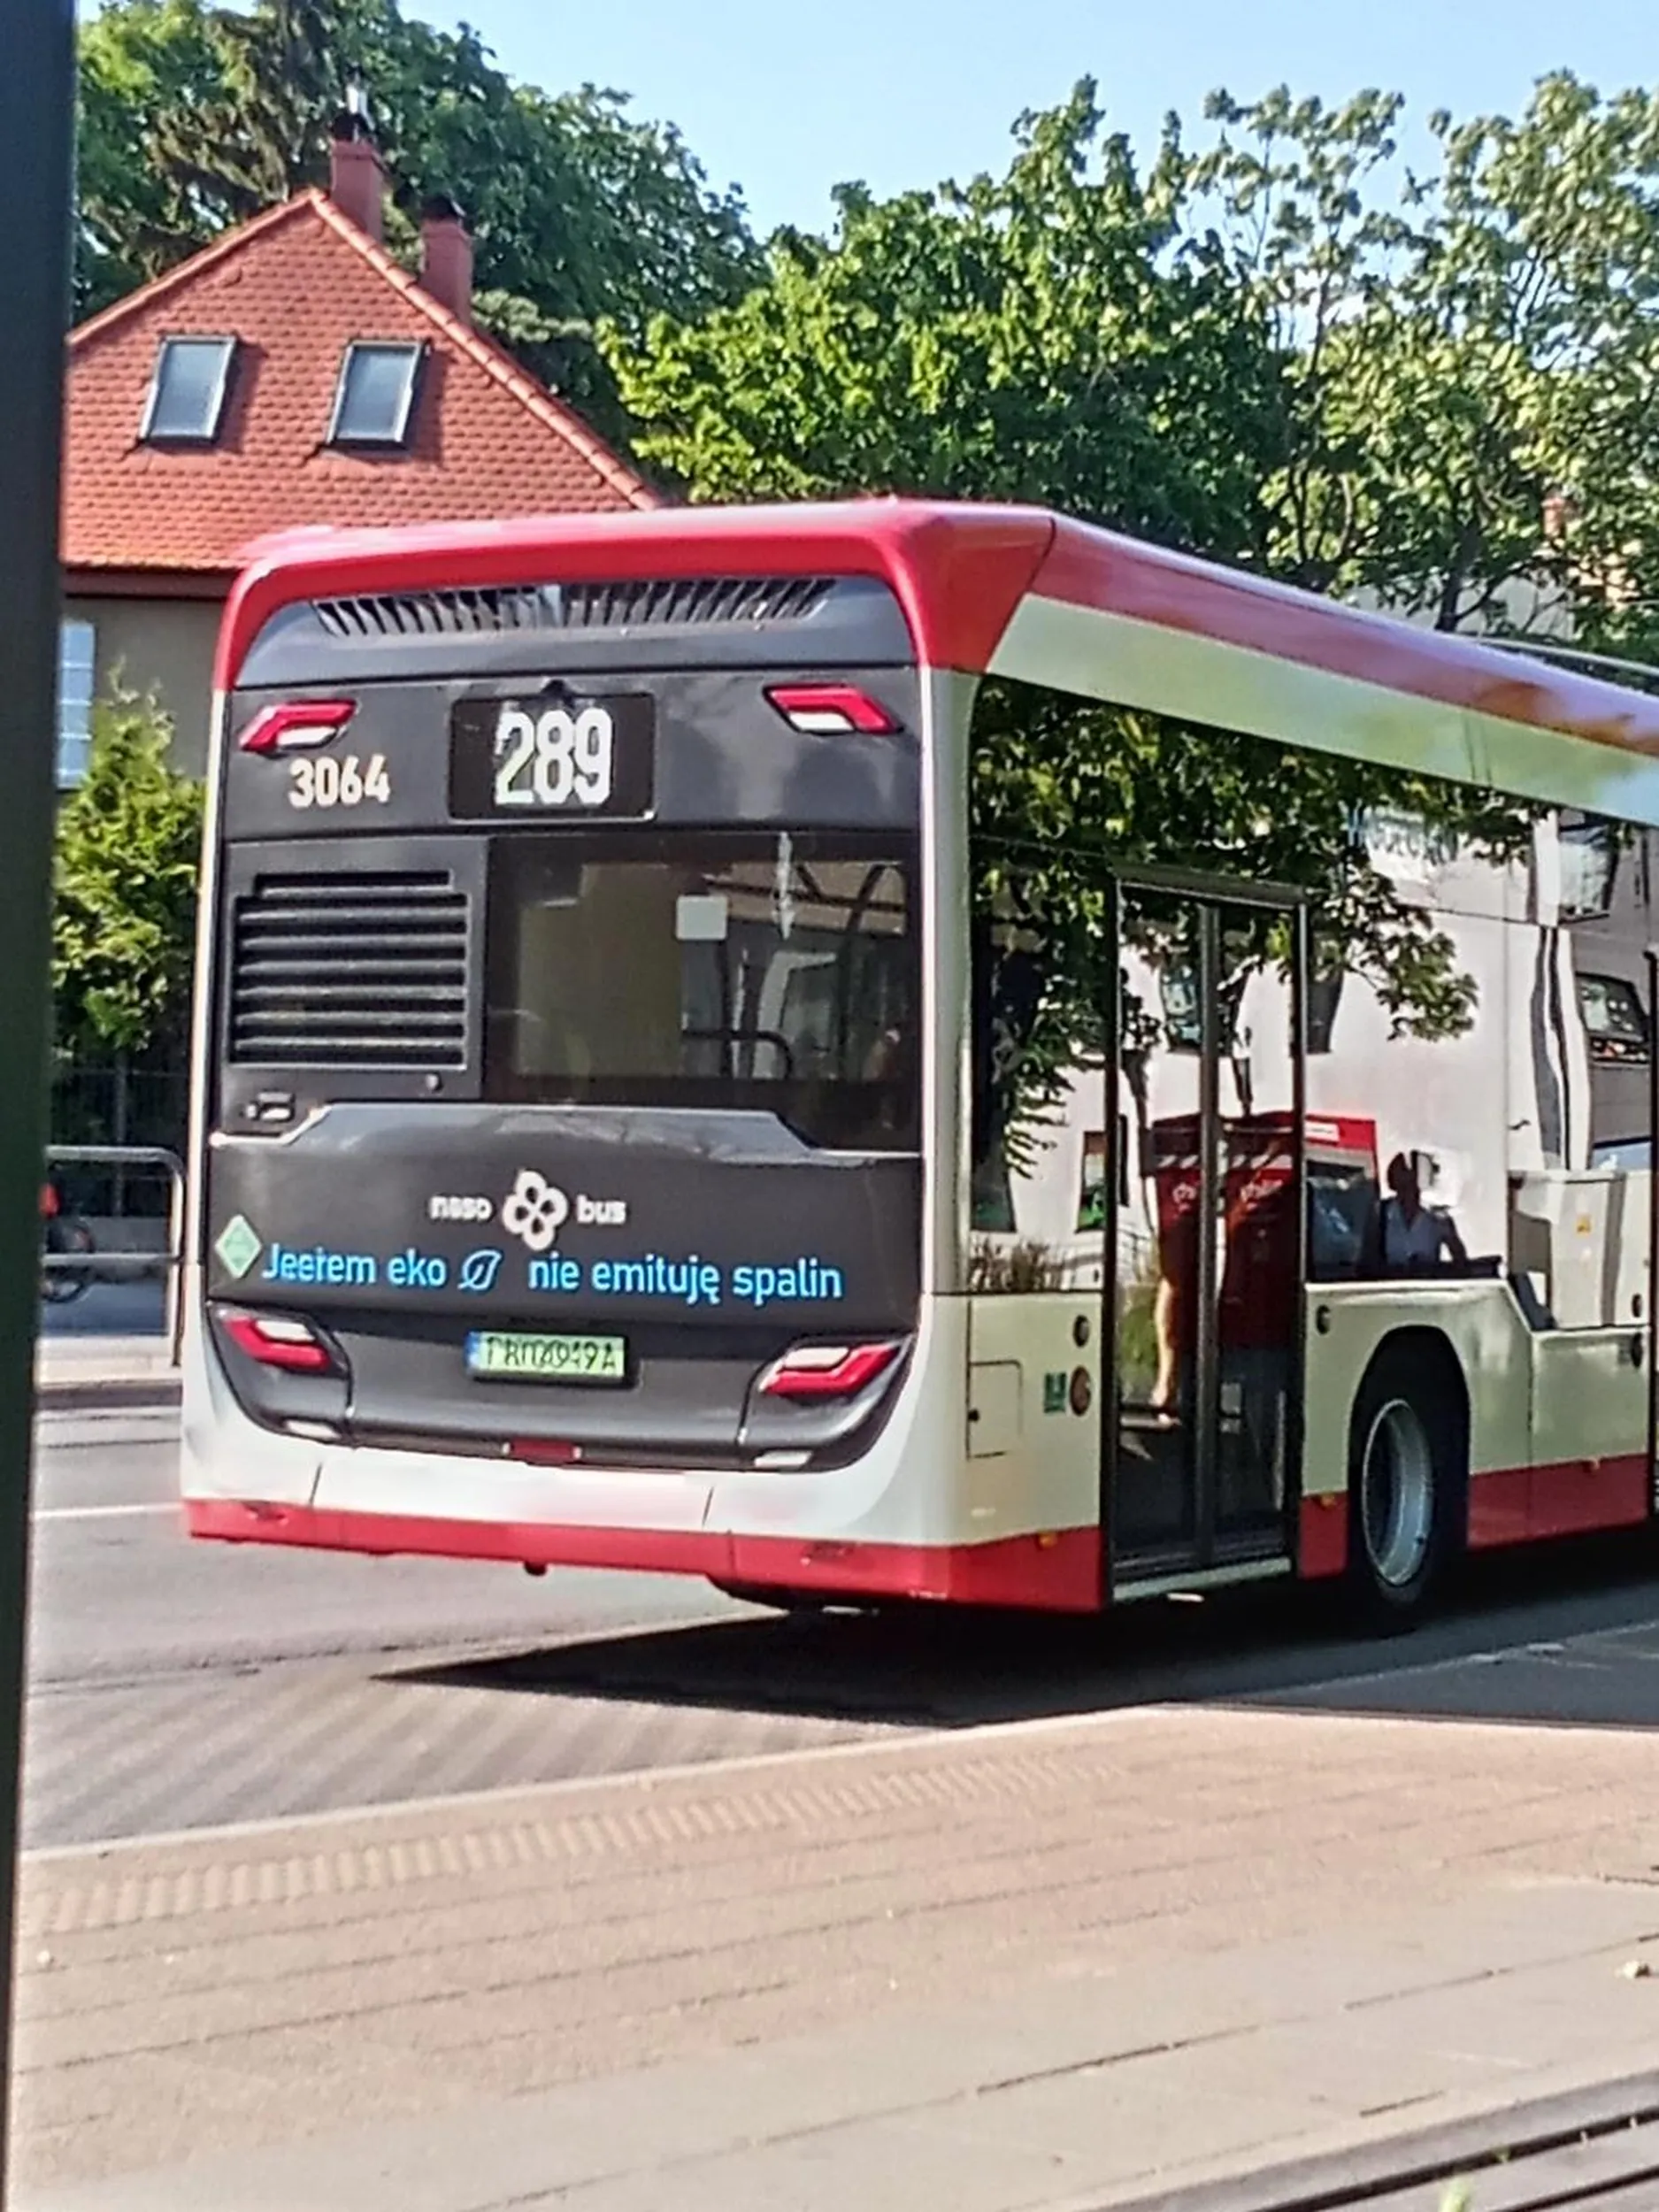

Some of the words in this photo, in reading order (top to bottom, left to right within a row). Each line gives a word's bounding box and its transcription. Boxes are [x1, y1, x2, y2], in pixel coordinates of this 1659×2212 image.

[288, 753, 391, 808] 3064
[494, 707, 613, 804] 289
[576, 1194, 627, 1224] bus
[388, 1248, 447, 1286] eko
[528, 1250, 580, 1290] nie
[591, 1253, 720, 1304] emituję
[733, 1256, 842, 1306] spalin
